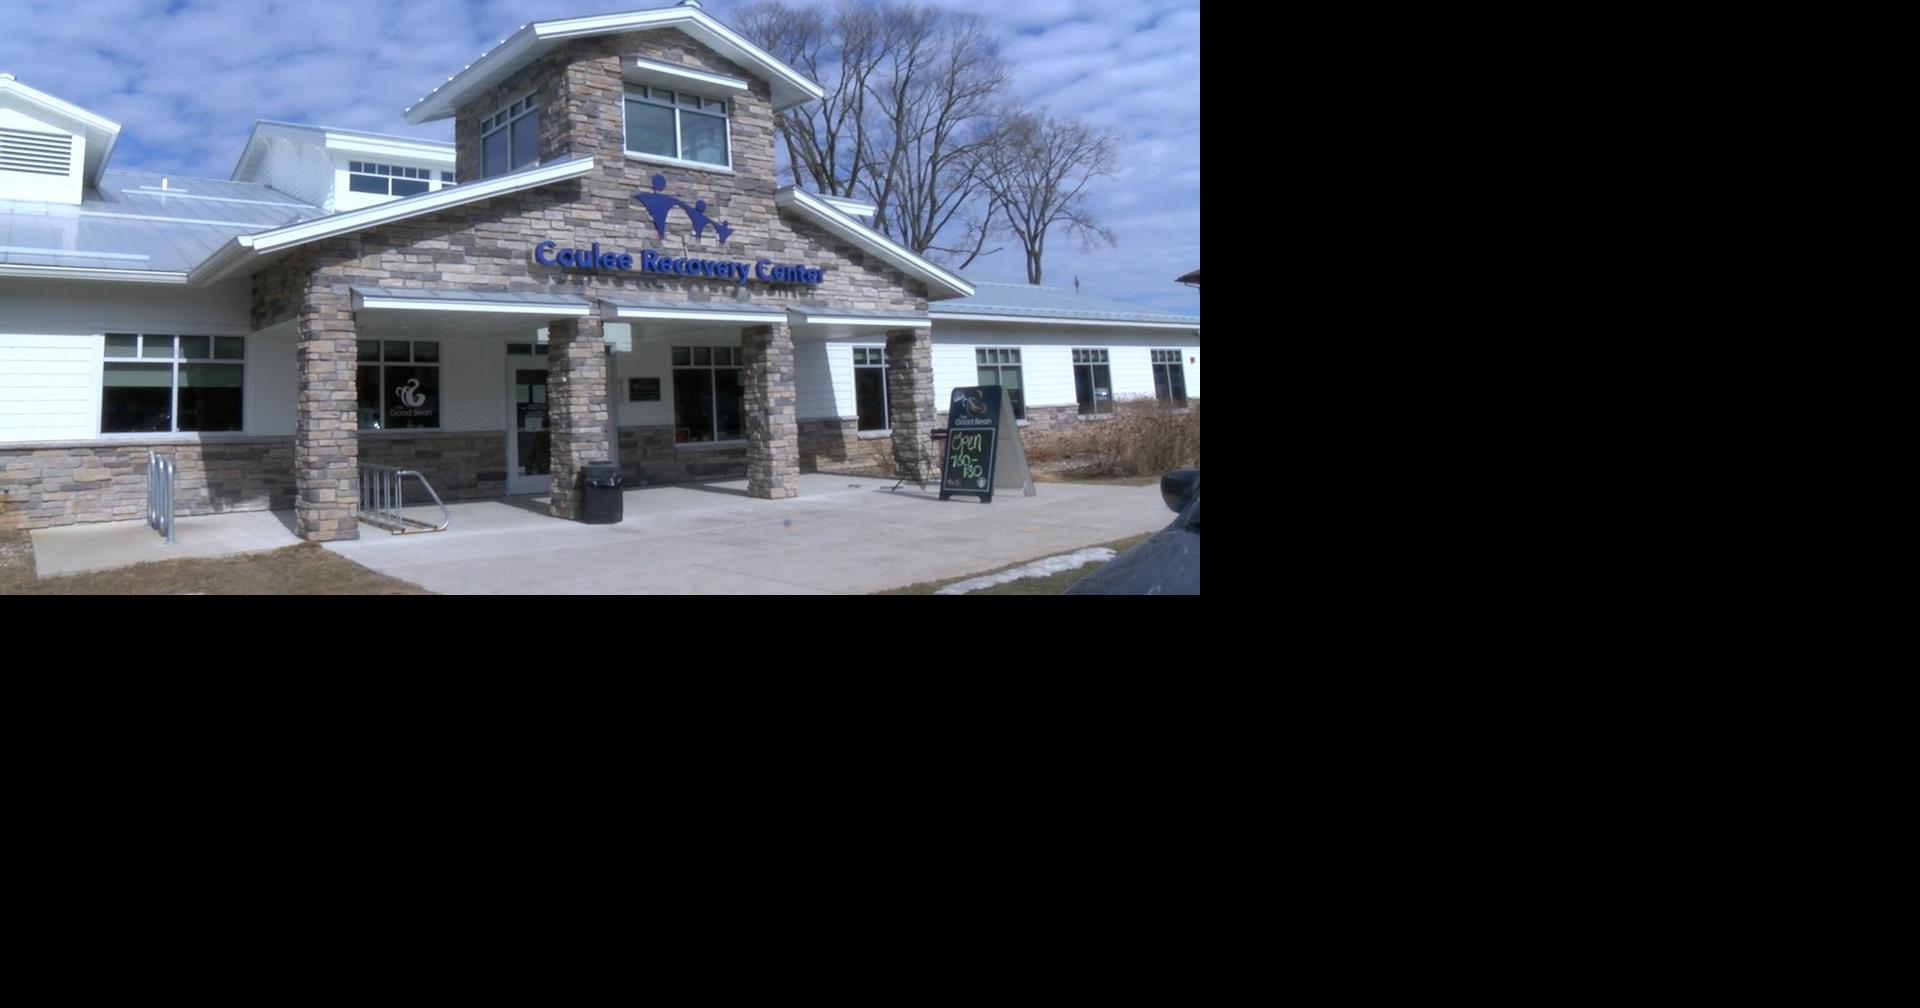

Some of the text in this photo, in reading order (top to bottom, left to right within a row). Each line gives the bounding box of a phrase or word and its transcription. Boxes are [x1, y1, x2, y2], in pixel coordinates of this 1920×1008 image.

[535, 241, 826, 284] Coulee Recovery Center
[390, 409, 412, 417] Good
[955, 417, 992, 426] Good Bean
